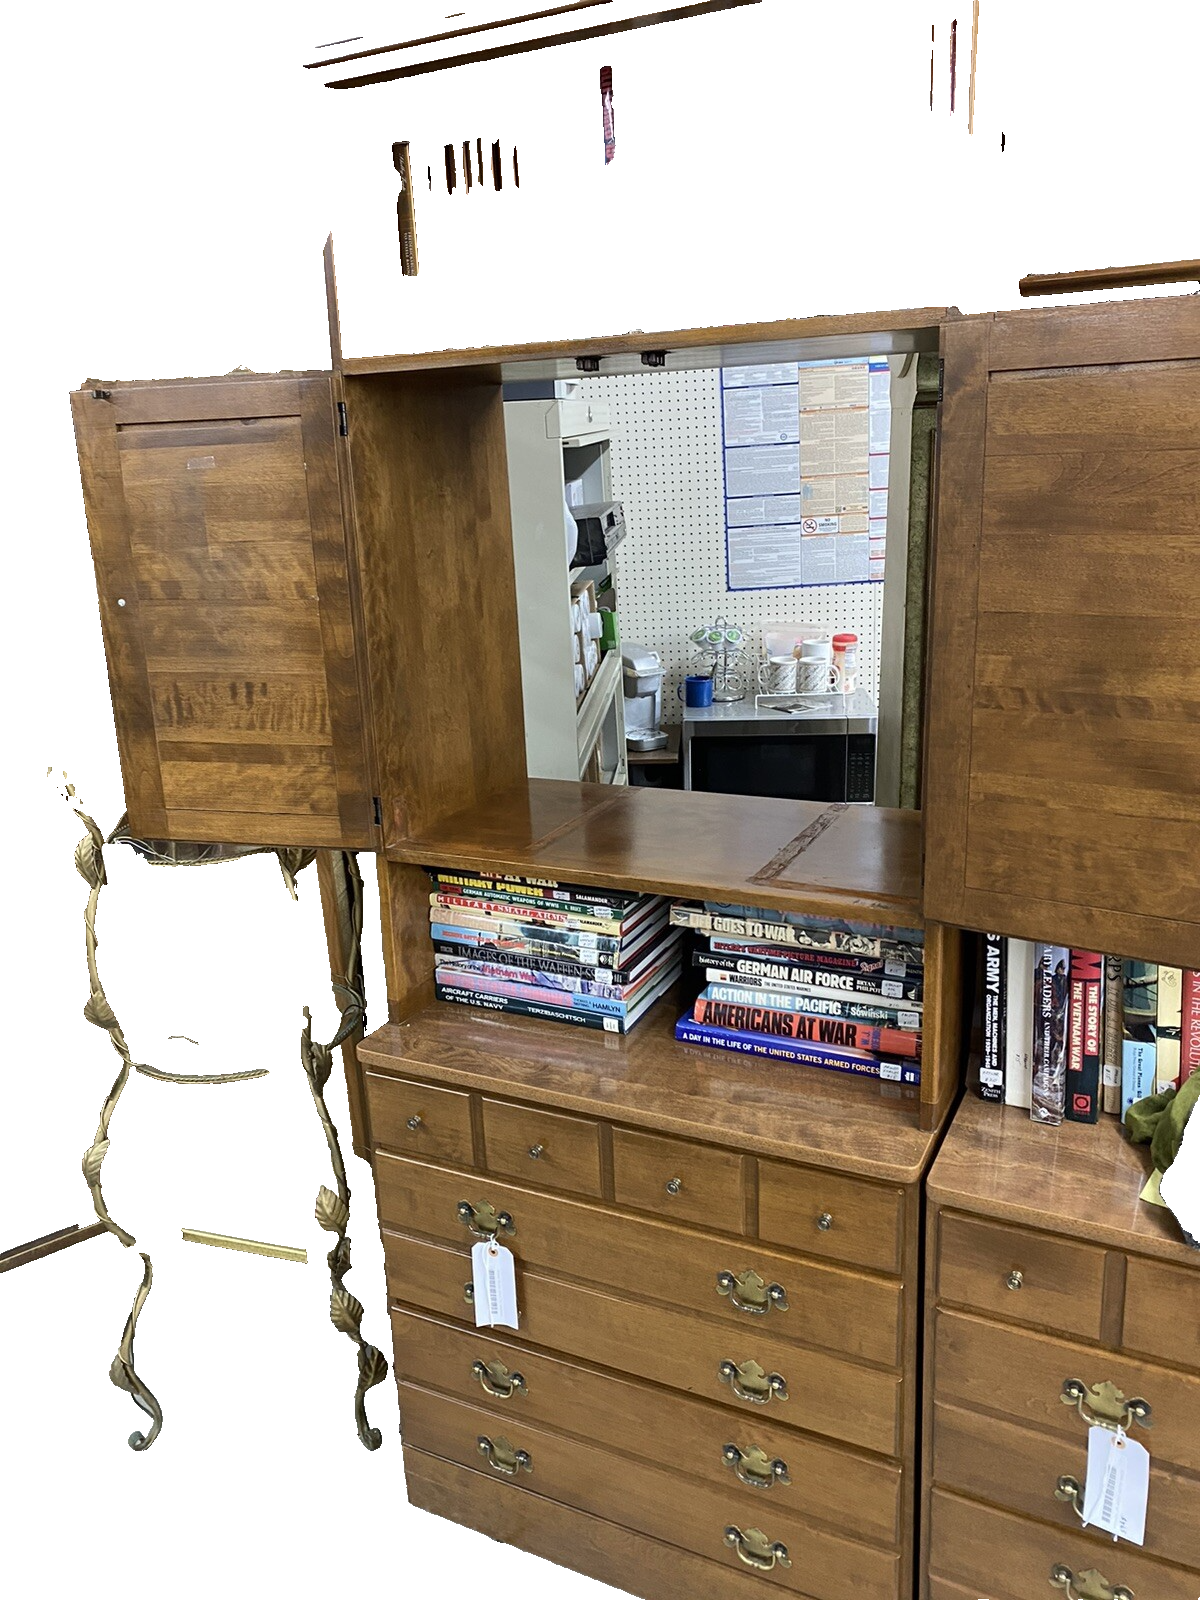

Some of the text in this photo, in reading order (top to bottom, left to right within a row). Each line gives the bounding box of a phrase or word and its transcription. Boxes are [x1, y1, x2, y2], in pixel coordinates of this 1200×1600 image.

[438, 874, 493, 889] MILITARY
[463, 888, 482, 896] GERMAN
[484, 892, 510, 900] AUTOMATIC
[512, 896, 535, 905] WEAPONS
[575, 894, 608, 903] SALAMANDER
[437, 895, 568, 922] MILITARY SMALL ARMS
[713, 917, 745, 935] GOES
[746, 921, 762, 937] TO
[764, 925, 796, 942] WAR
[458, 946, 497, 962] IMAGES
[498, 953, 511, 965] OF
[514, 956, 535, 970] THE
[719, 959, 726, 967] of
[726, 960, 735, 968] the
[782, 951, 815, 962] PICTURE
[816, 954, 857, 967] MAGAZINE
[1043, 945, 1053, 968] ARY
[482, 963, 517, 978] Vietnam
[737, 959, 854, 991] GERMAN AIR FORCE
[986, 945, 1000, 994] ARMY
[729, 973, 762, 986] WARRIORS
[856, 979, 876, 987] BRYAN
[1192, 981, 1200, 992] IN
[441, 987, 508, 1004] AIRCRAFT CARRIERS
[712, 987, 841, 1015] ACTION IN THE PACIFIC
[1042, 970, 1052, 1018] LEADERS
[470, 998, 482, 1006] U.S.
[483, 1001, 504, 1010] NAVY
[592, 1002, 620, 1013] HAMLYN
[1191, 997, 1200, 1016] THE
[703, 1001, 793, 1038] AMERICANS
[796, 1016, 816, 1041] AT
[819, 1019, 857, 1047] WAR
[1071, 982, 1082, 1070] THE VIETNAM WAR
[1086, 985, 1098, 1052] THE STORY OF
[683, 1032, 688, 1040] A
[689, 1033, 701, 1042] DAY
[712, 1037, 725, 1047] THE
[727, 1040, 741, 1049] LIFE
[742, 1042, 752, 1051] OF
[754, 1045, 767, 1054] THE
[769, 1046, 795, 1059] UNITED
[796, 1053, 822, 1064] STATES
[824, 1058, 850, 1069] ARMED
[851, 1063, 880, 1075] FORCES
